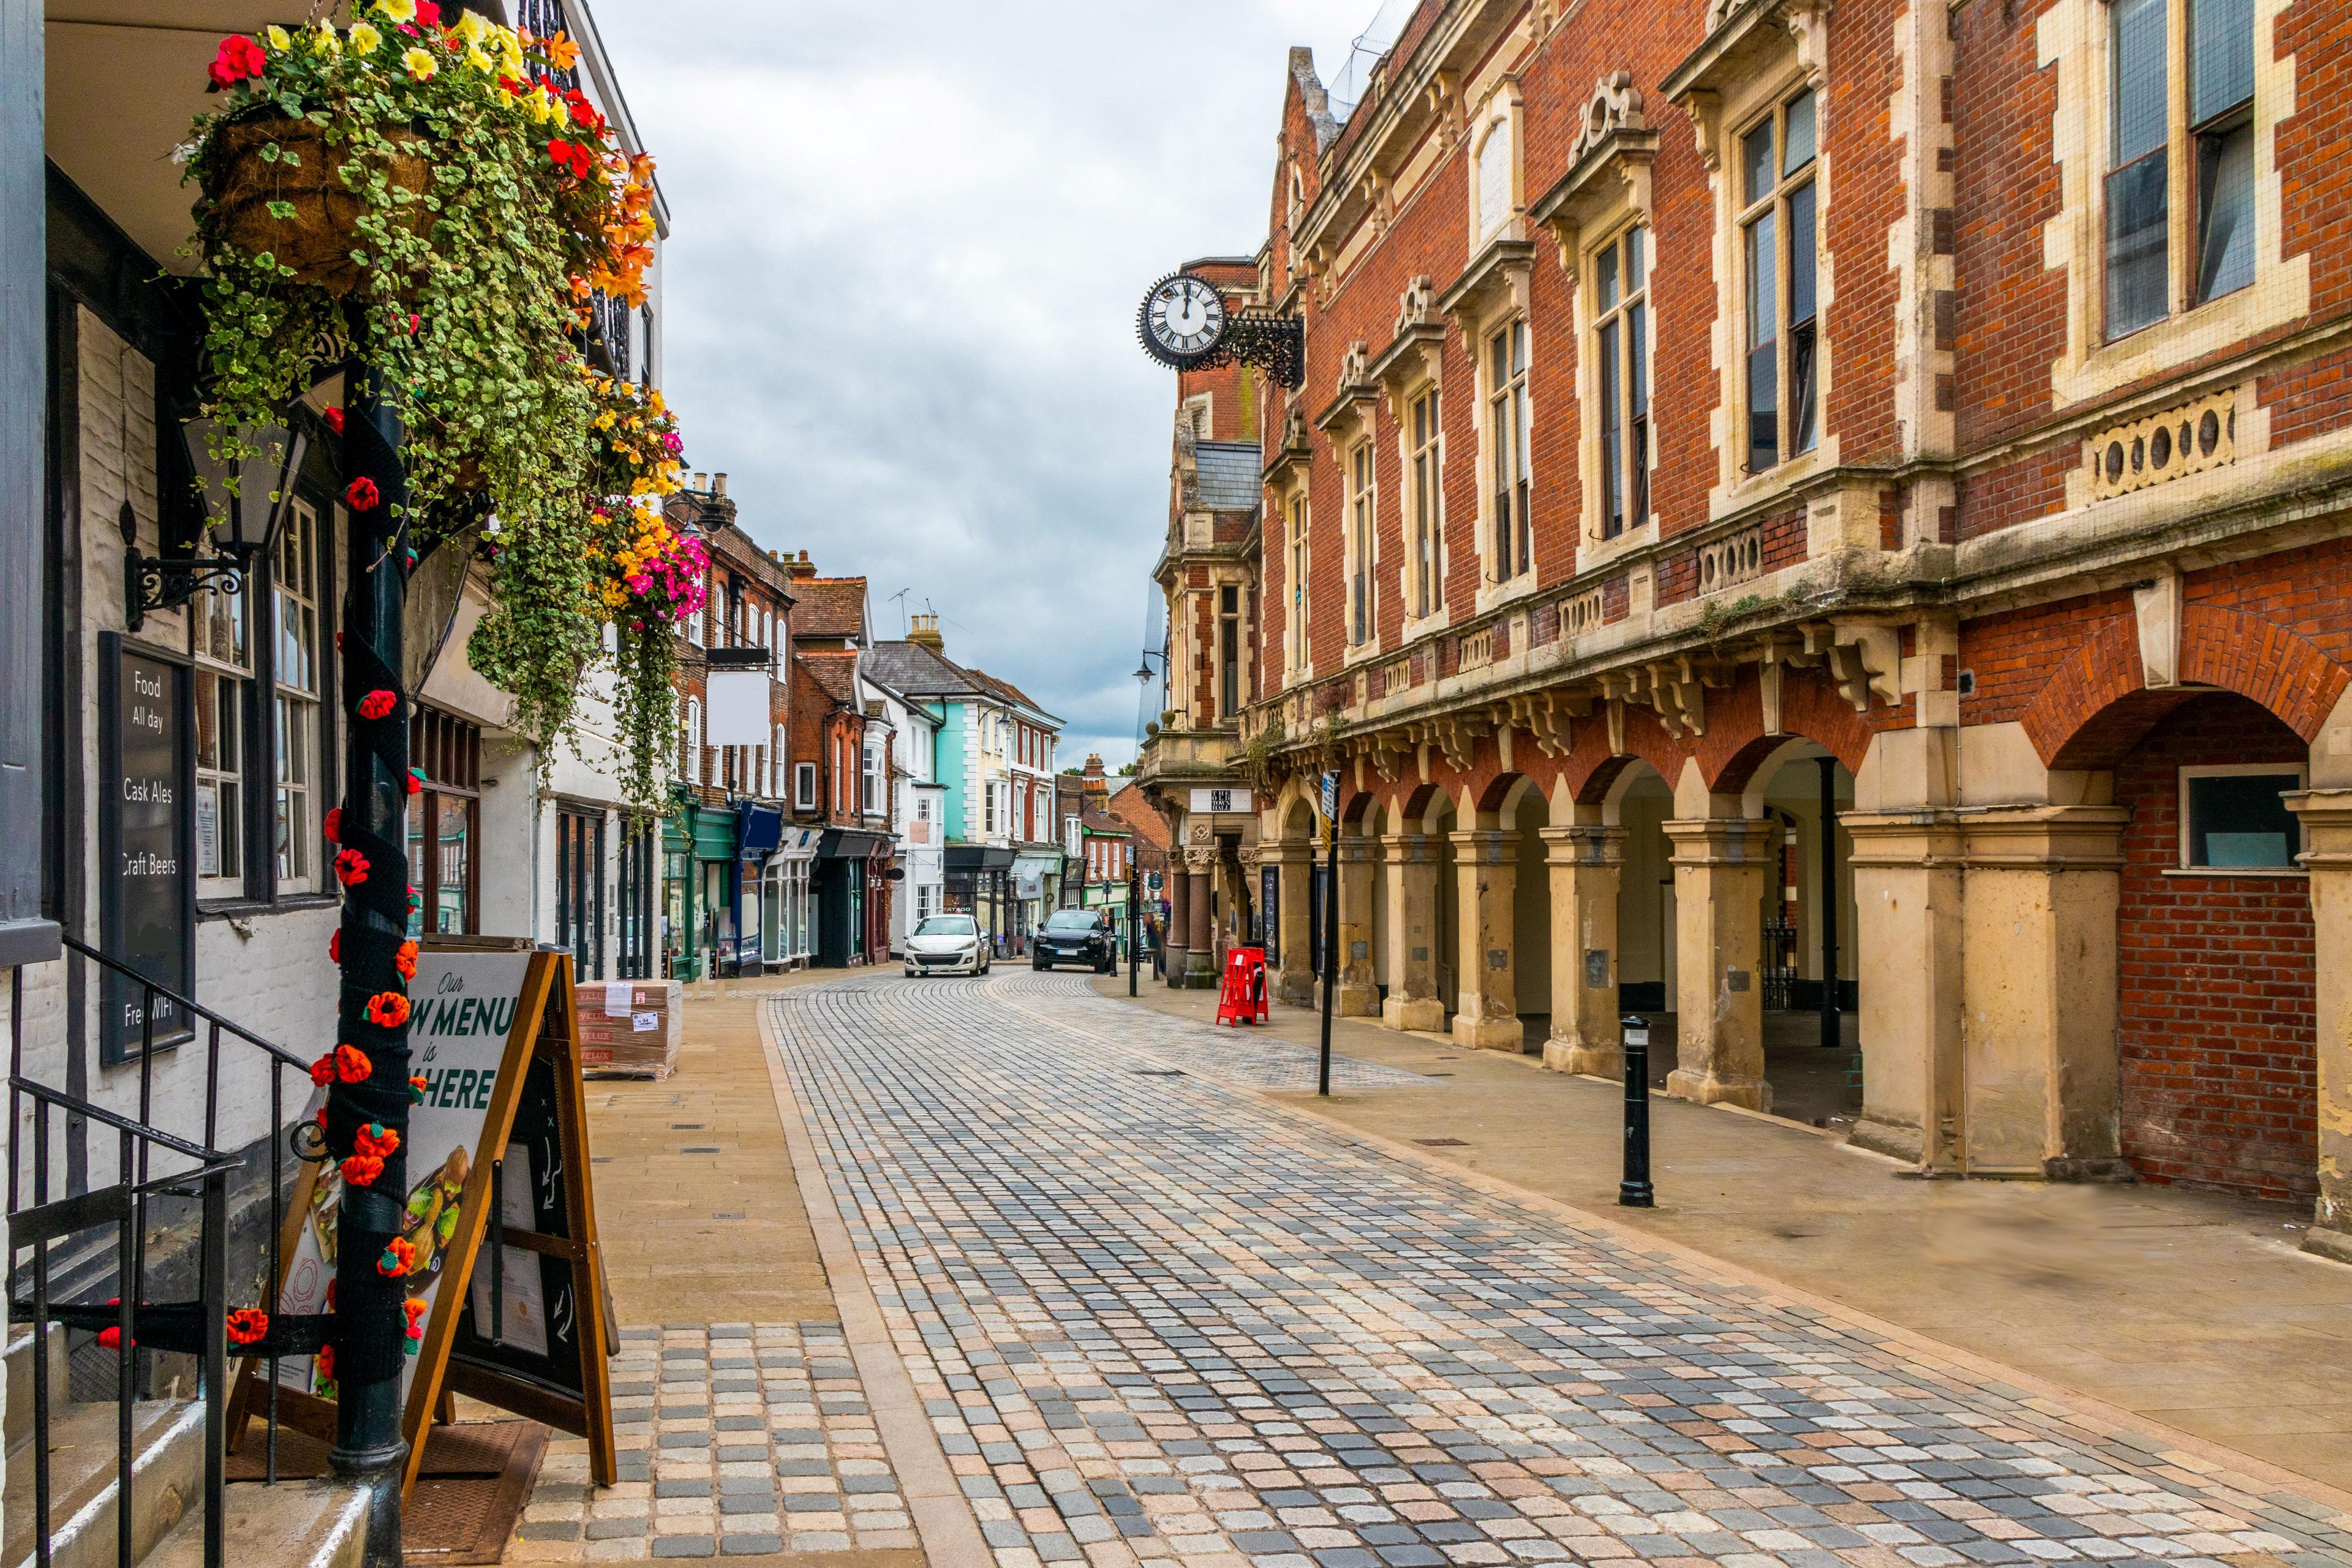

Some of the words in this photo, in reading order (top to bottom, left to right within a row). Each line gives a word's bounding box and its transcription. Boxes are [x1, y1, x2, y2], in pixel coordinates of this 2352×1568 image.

[135, 670, 160, 698] Food
[133, 706, 145, 726] All
[148, 708, 164, 734] day
[124, 777, 148, 802] Cask
[152, 780, 172, 804] Ales
[149, 853, 176, 875] Beers
[438, 972, 464, 995] Our
[125, 1003, 145, 1027] Fre
[429, 997, 518, 1036] MENU
[423, 1041, 437, 1061] is
